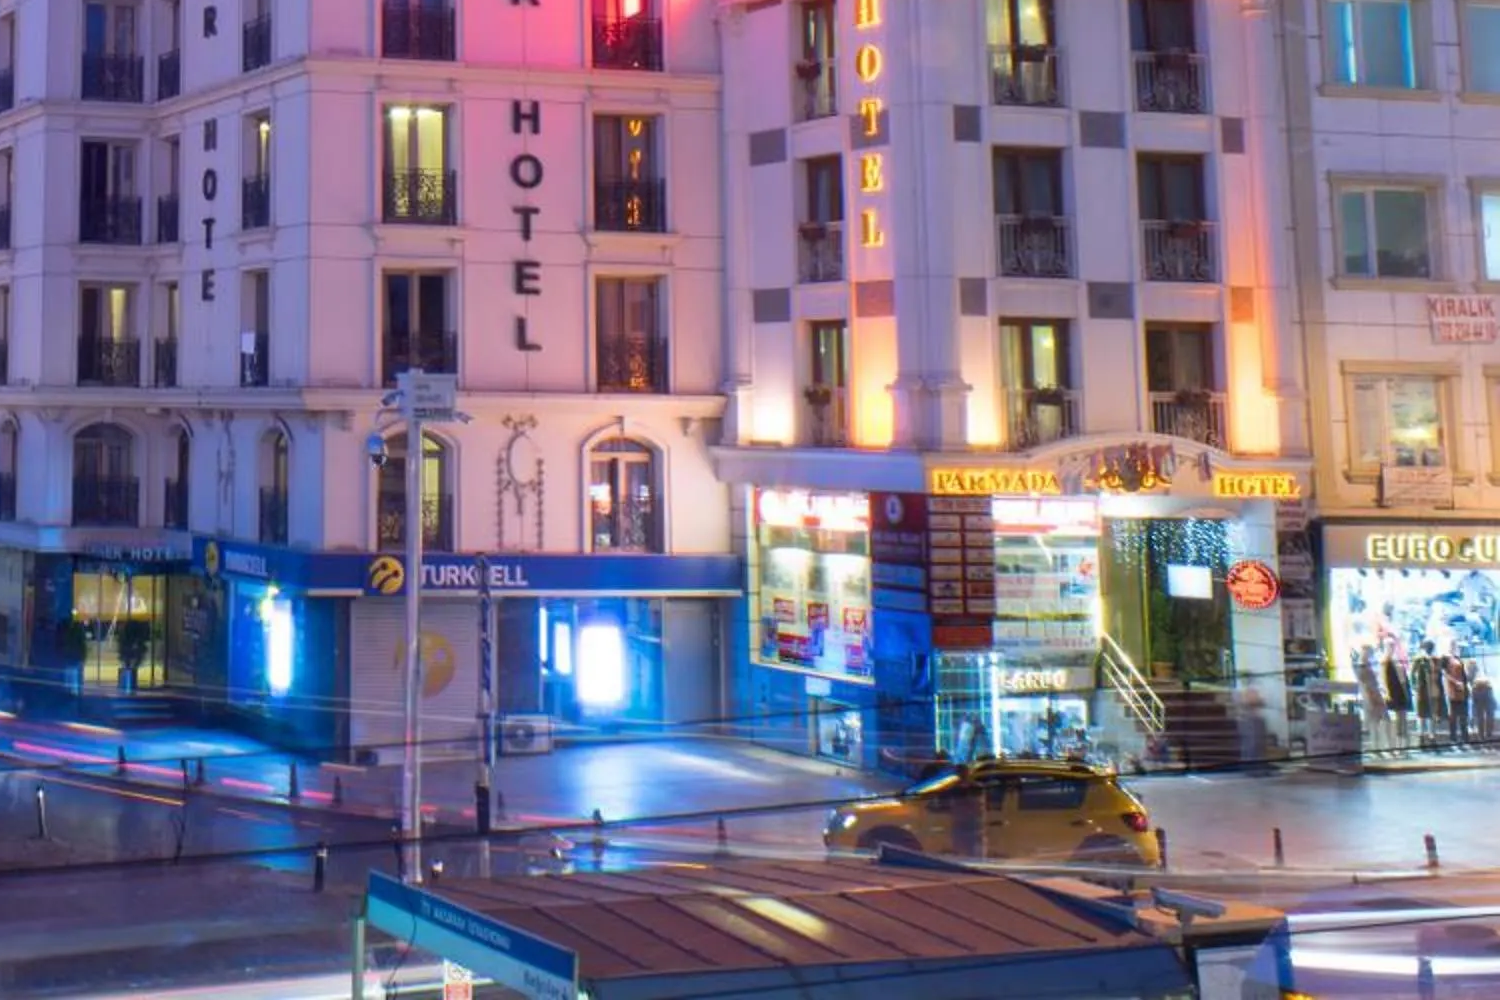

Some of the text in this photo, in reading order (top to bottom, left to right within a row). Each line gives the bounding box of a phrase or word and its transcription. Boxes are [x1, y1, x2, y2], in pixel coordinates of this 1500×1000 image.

[509, 100, 543, 352] HOTEL
[931, 468, 1301, 497] PARMADA HOTEL
[420, 564, 529, 586] TURKELL
